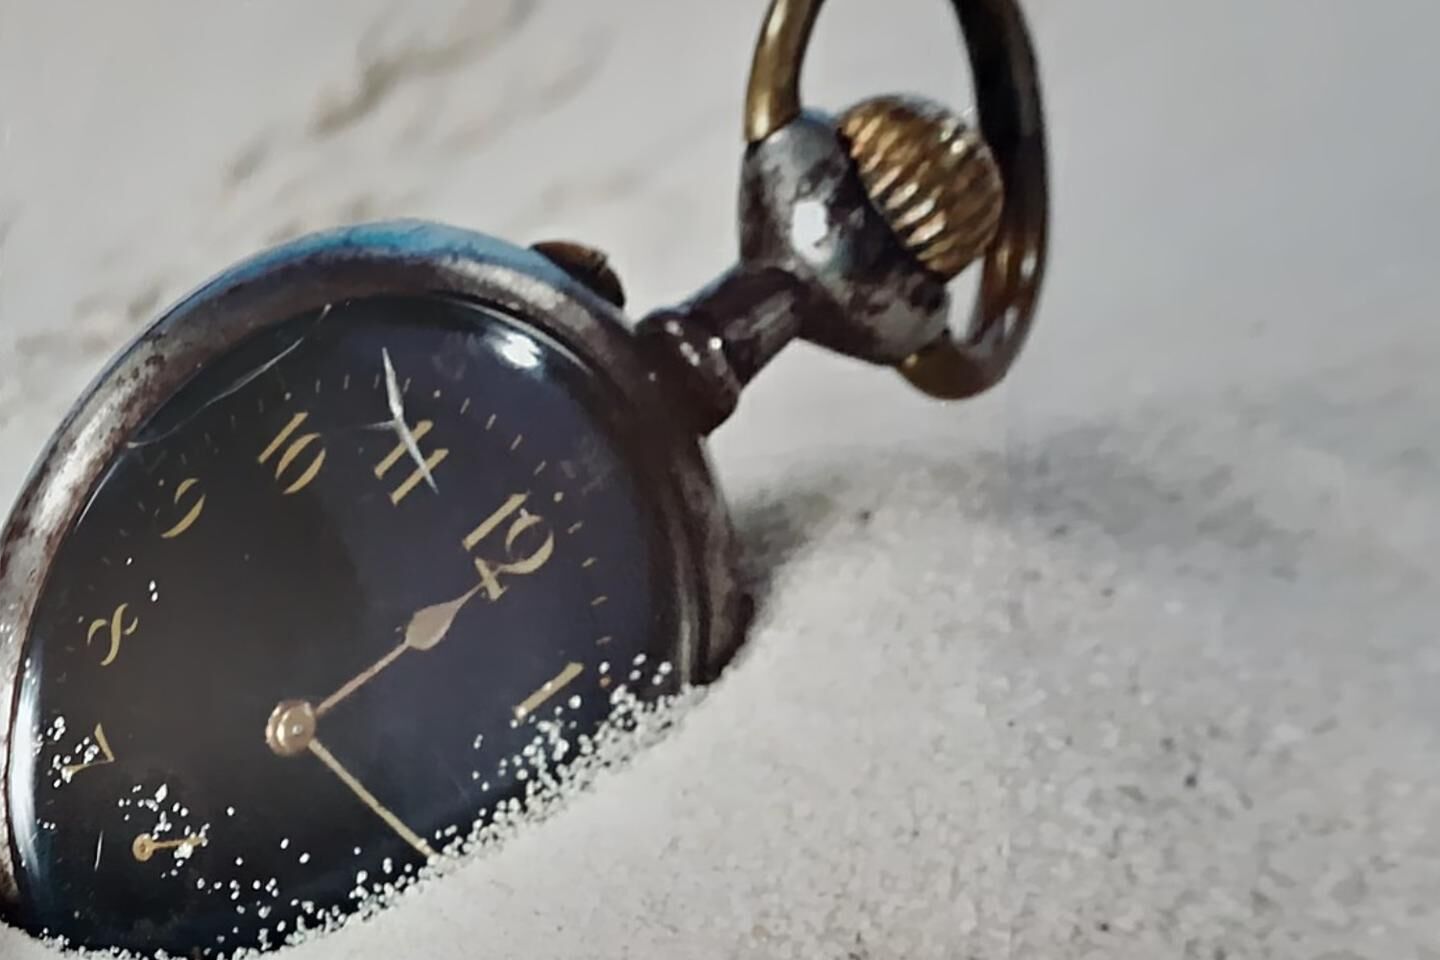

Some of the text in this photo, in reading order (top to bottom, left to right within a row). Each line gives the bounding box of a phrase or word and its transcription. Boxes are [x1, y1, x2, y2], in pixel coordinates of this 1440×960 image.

[258, 411, 326, 495] 10
[160, 477, 205, 538] 9
[462, 492, 554, 600] 12
[86, 603, 138, 667] 8
